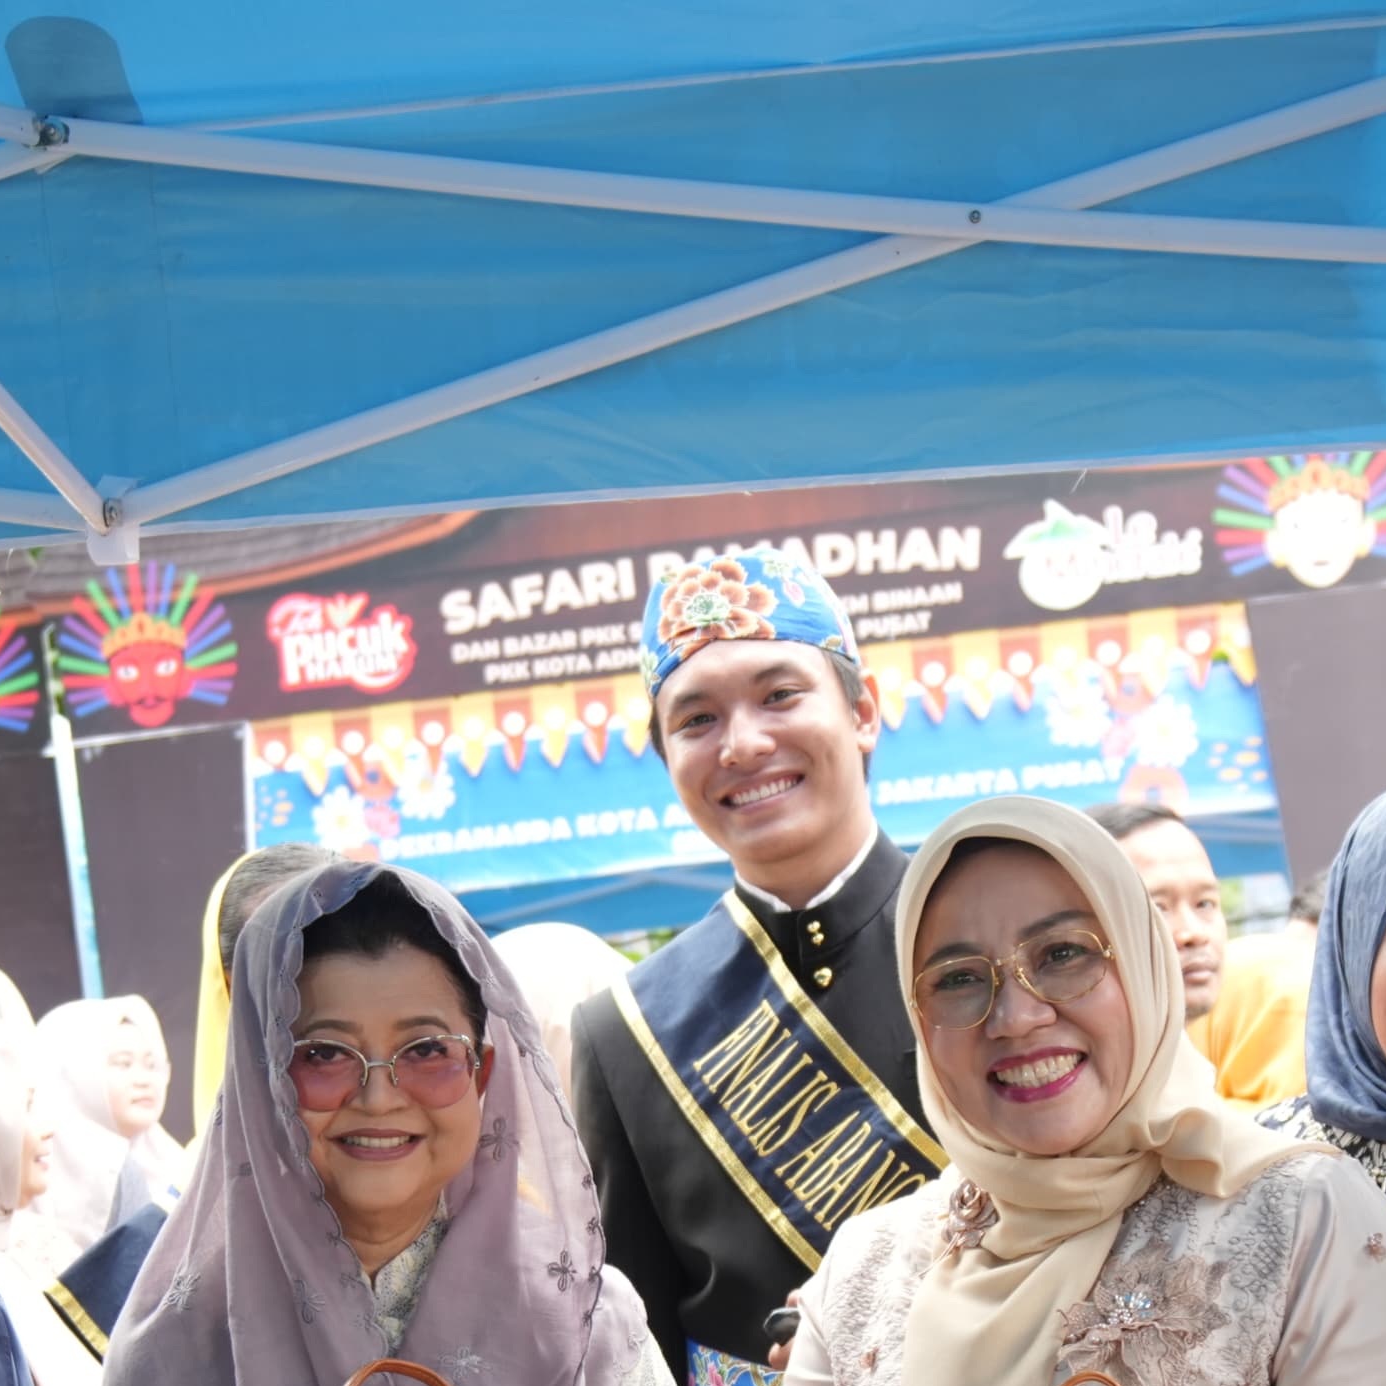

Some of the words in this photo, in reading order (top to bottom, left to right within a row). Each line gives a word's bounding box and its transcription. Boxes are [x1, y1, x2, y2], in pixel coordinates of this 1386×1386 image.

[440, 557, 636, 634] SAFARI
[871, 582, 963, 612] BINAAN
[856, 611, 931, 639] PUSAT
[451, 639, 500, 663] DAN
[503, 630, 577, 656] BAZAR
[579, 621, 626, 646] PKK
[484, 659, 531, 684] PKK
[532, 653, 593, 678] KOTA
[574, 806, 659, 838] KOTA
[693, 999, 841, 1157] FINALIS
